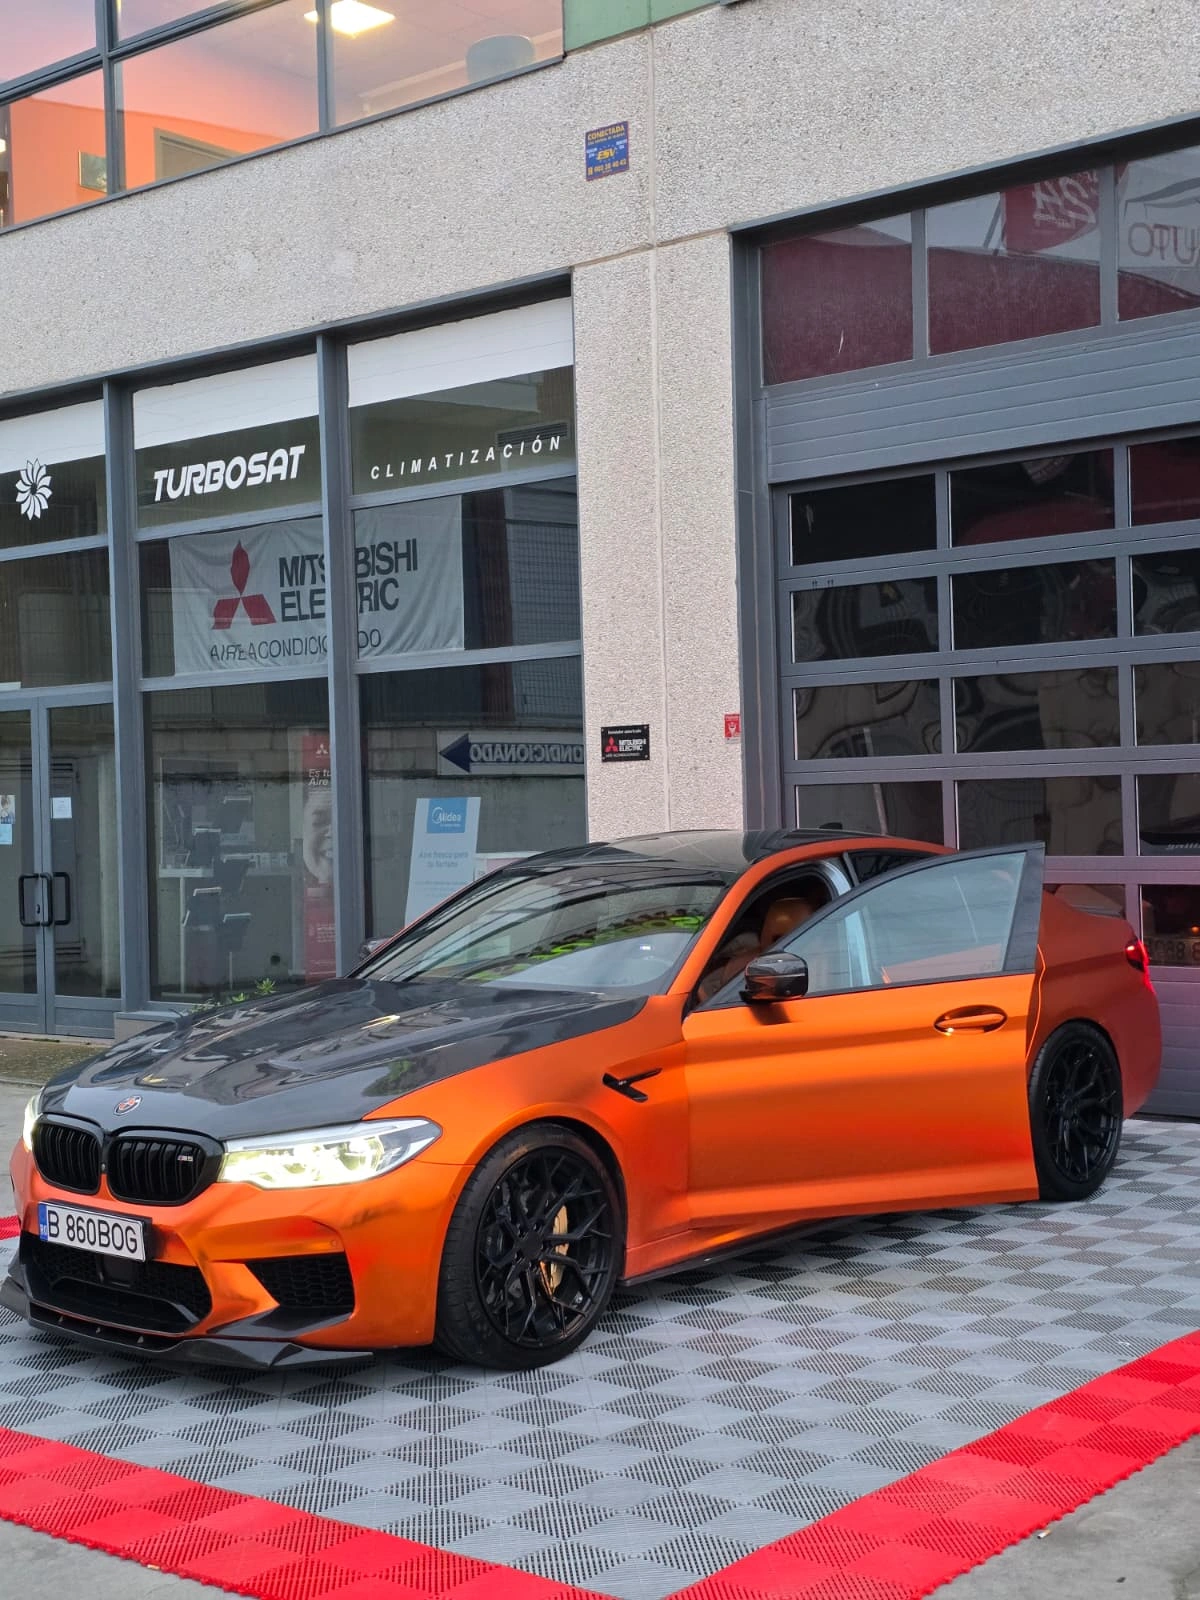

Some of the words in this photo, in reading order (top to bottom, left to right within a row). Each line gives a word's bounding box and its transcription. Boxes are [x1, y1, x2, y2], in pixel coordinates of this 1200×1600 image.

[153, 444, 306, 502] TURBOSAT
[370, 434, 560, 480] CLIMATIZACIÓN
[280, 577, 399, 622] ELERIC
[47, 1209, 59, 1238] B
[66, 1214, 138, 1254] 860BOG
